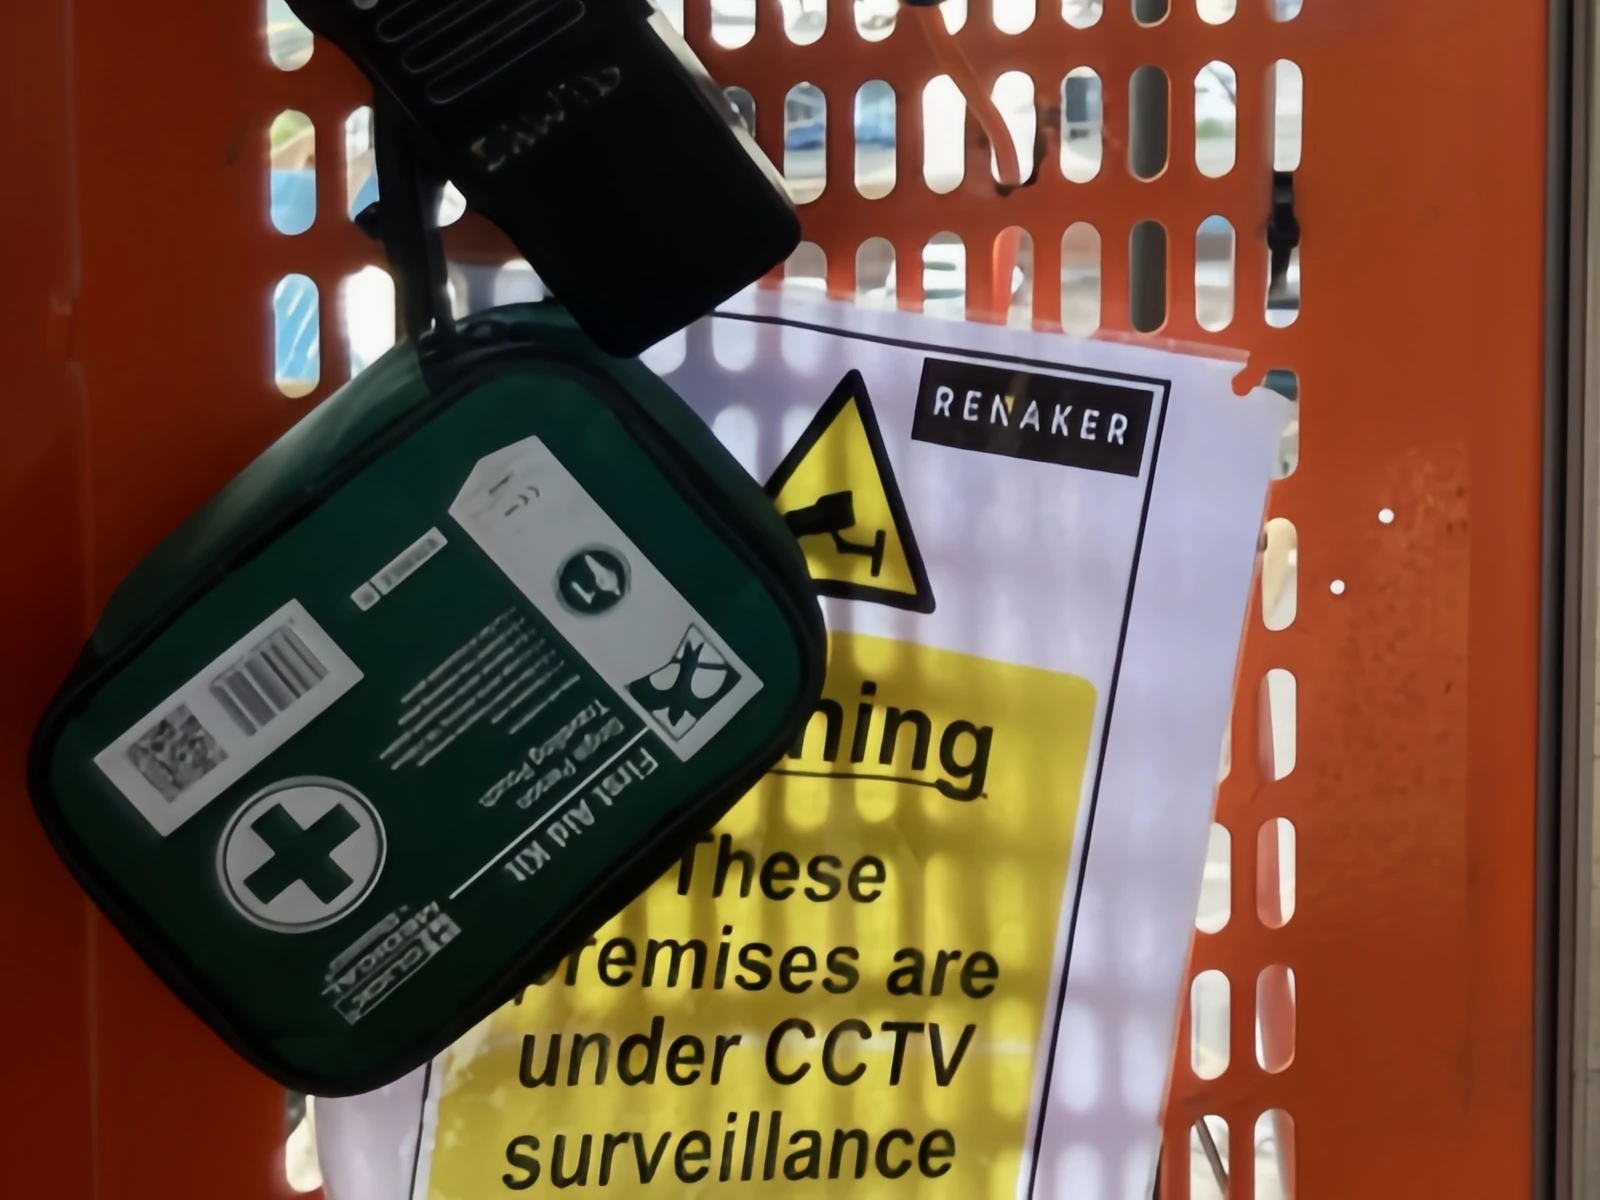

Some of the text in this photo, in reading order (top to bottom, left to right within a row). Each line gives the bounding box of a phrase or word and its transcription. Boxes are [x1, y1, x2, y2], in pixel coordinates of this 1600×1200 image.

[932, 385, 1129, 446] RENAKER
[784, 680, 994, 803] ning
[547, 797, 596, 848] Aid
[503, 839, 552, 882] Kit
[675, 831, 887, 904] These
[513, 923, 1000, 1007] remises are
[518, 1015, 977, 1089] under CCTV
[501, 1109, 957, 1191] surveillance
